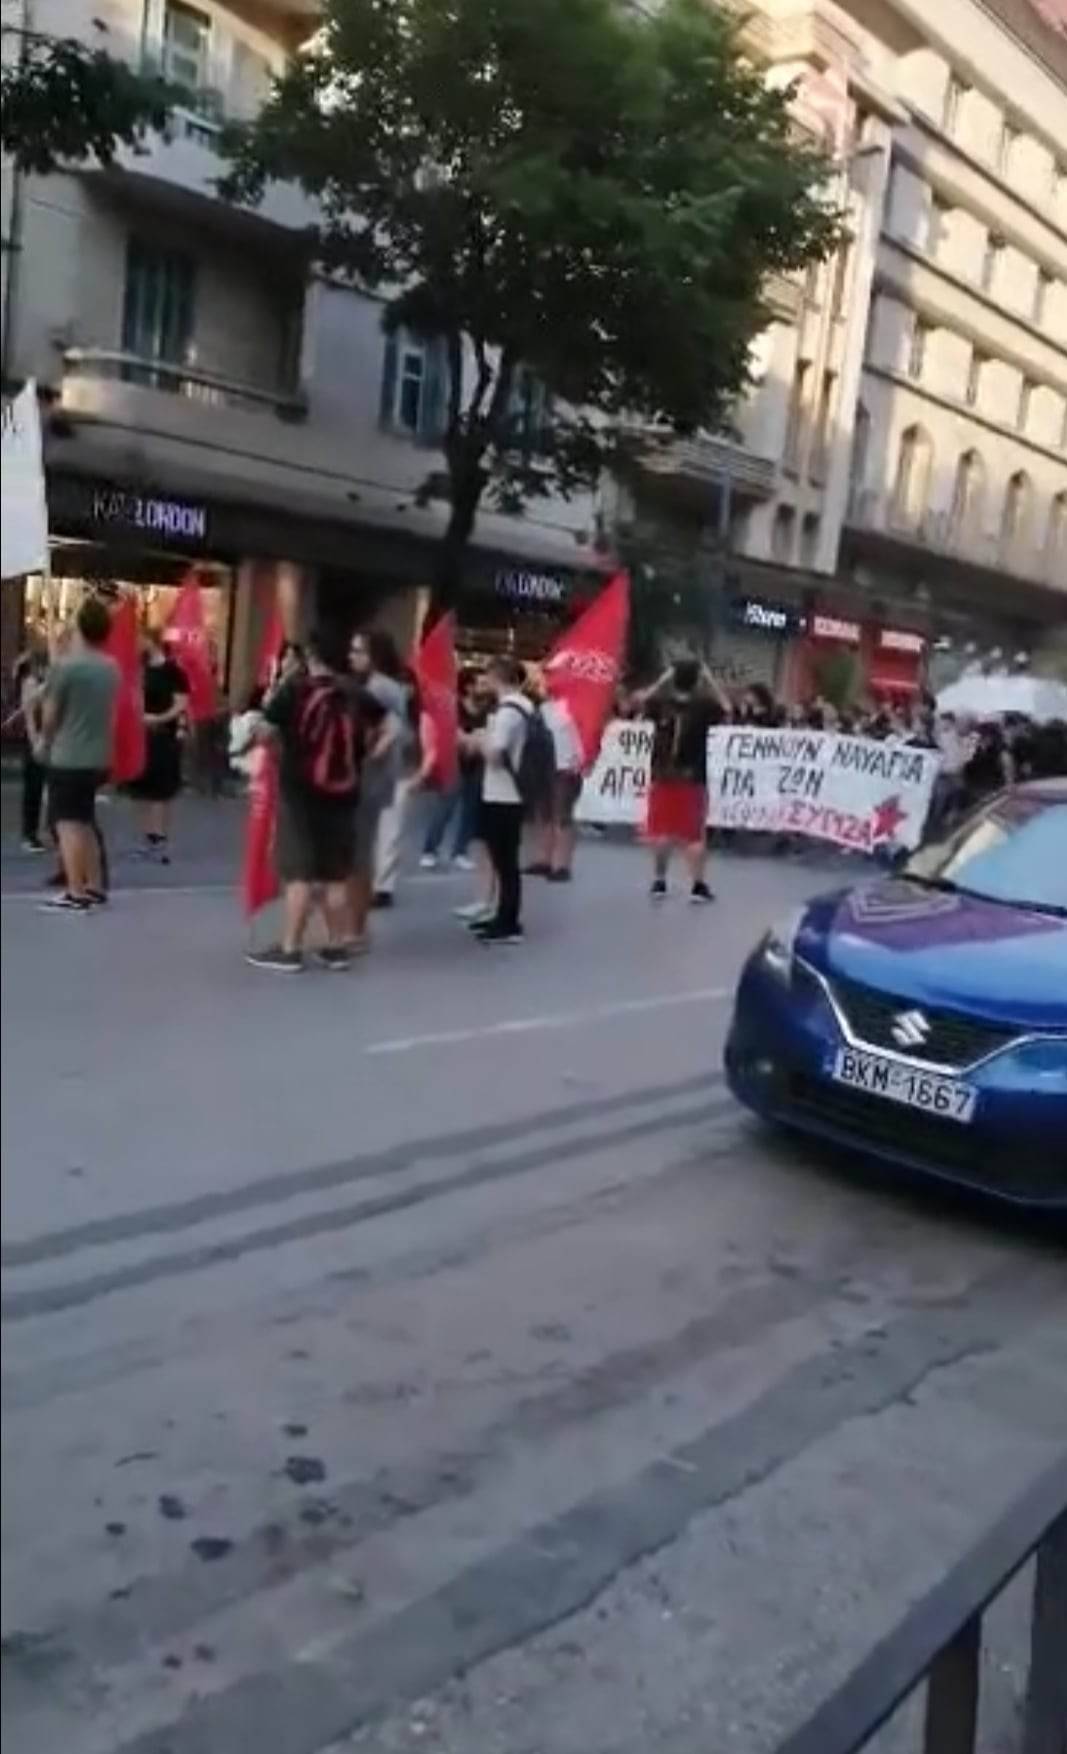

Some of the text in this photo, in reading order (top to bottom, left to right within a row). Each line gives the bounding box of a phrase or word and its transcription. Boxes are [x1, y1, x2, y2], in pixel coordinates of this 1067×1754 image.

[135, 497, 205, 537] LONDON
[726, 733, 826, 761] ΓΕΝΝΟΥΝ
[832, 742, 925, 784] ΝΑΥΑΓΙΑ
[721, 767, 754, 797] ΓΙΑ
